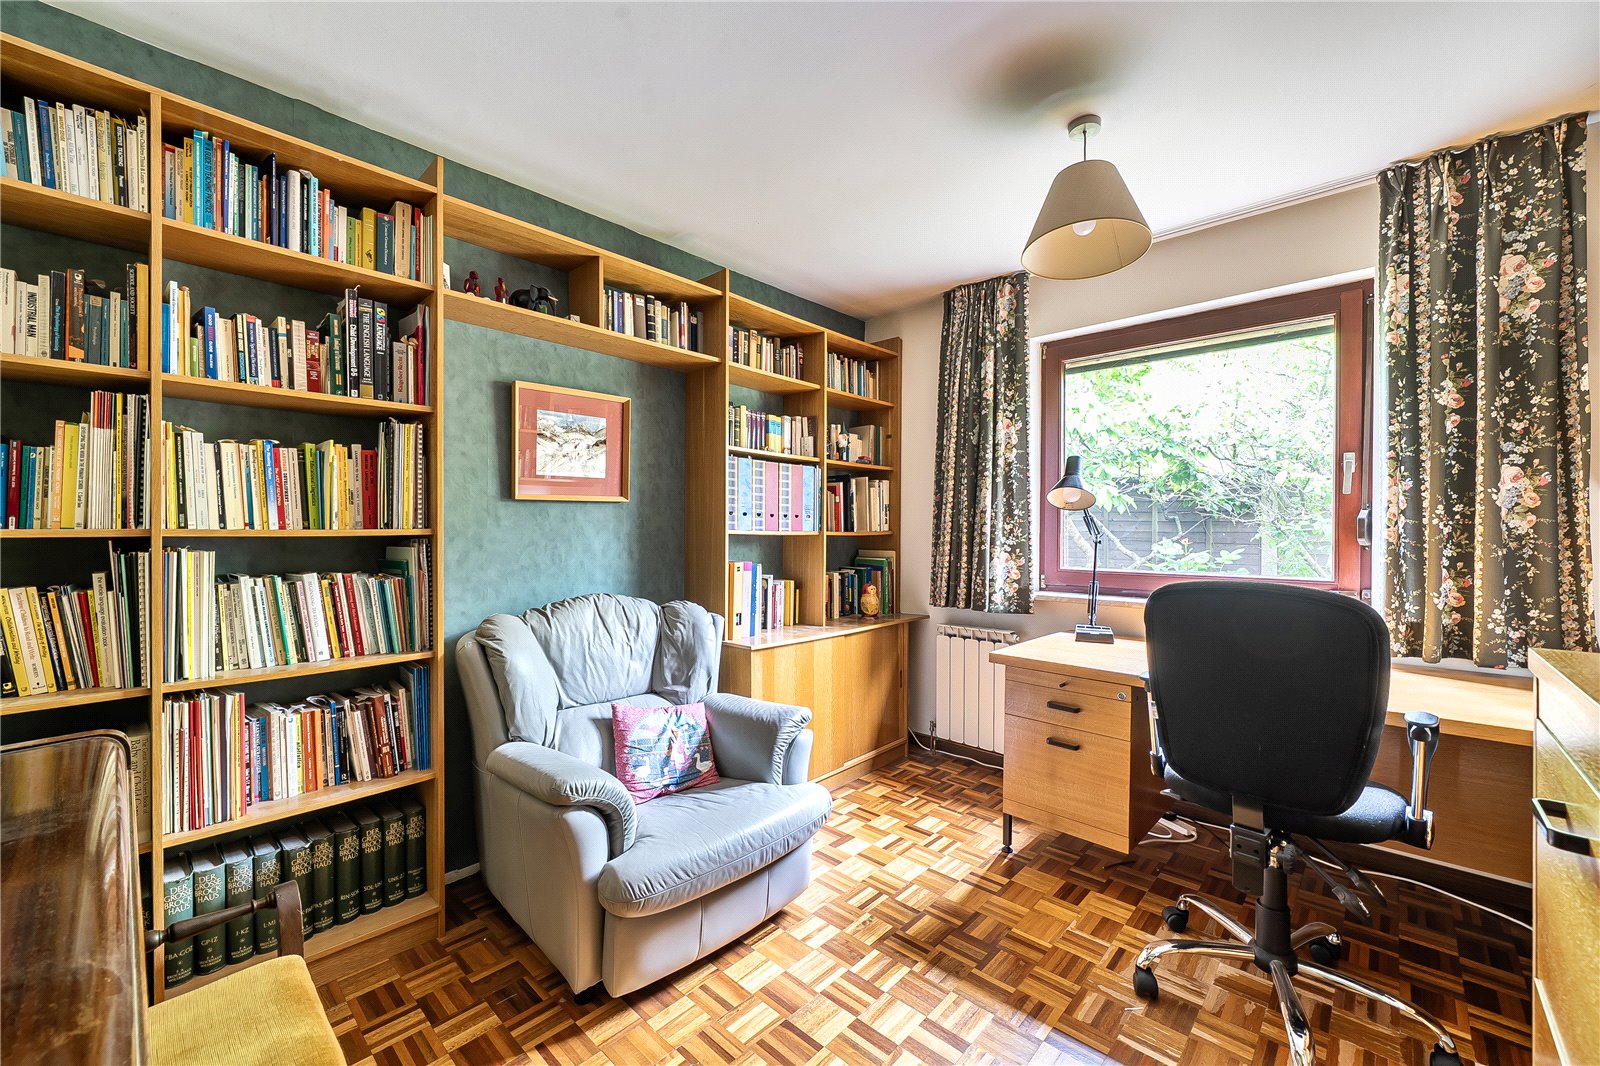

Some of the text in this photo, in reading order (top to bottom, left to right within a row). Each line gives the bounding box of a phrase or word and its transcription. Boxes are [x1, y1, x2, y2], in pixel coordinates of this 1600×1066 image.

[27, 292, 37, 338] INDUSTRIAL MAN
[349, 337, 357, 367] Development
[363, 348, 371, 377] LANGUAGE
[97, 597, 106, 615] language
[390, 820, 402, 830] DER
[366, 828, 379, 836] DER
[344, 834, 357, 844] DER
[315, 842, 330, 851] DER
[364, 845, 381, 854] HAUS
[296, 848, 311, 859] DER
[342, 852, 359, 862] HAUS
[261, 858, 277, 868] DER
[313, 860, 332, 870] HAUS
[233, 865, 248, 875] DER
[256, 869, 280, 881] BROCK
[295, 866, 312, 877] HAUS
[195, 877, 222, 891] GROSSE
[198, 874, 216, 884] DER
[228, 877, 253, 890] BROCK
[260, 877, 280, 888] HAUS
[170, 884, 188, 894] DER
[195, 884, 222, 897] BROCK
[231, 884, 252, 895] HAUS
[164, 888, 192, 903] GROSSE
[197, 892, 219, 903] HAUS
[164, 895, 193, 910] BROCK
[168, 903, 191, 916] HAUS
